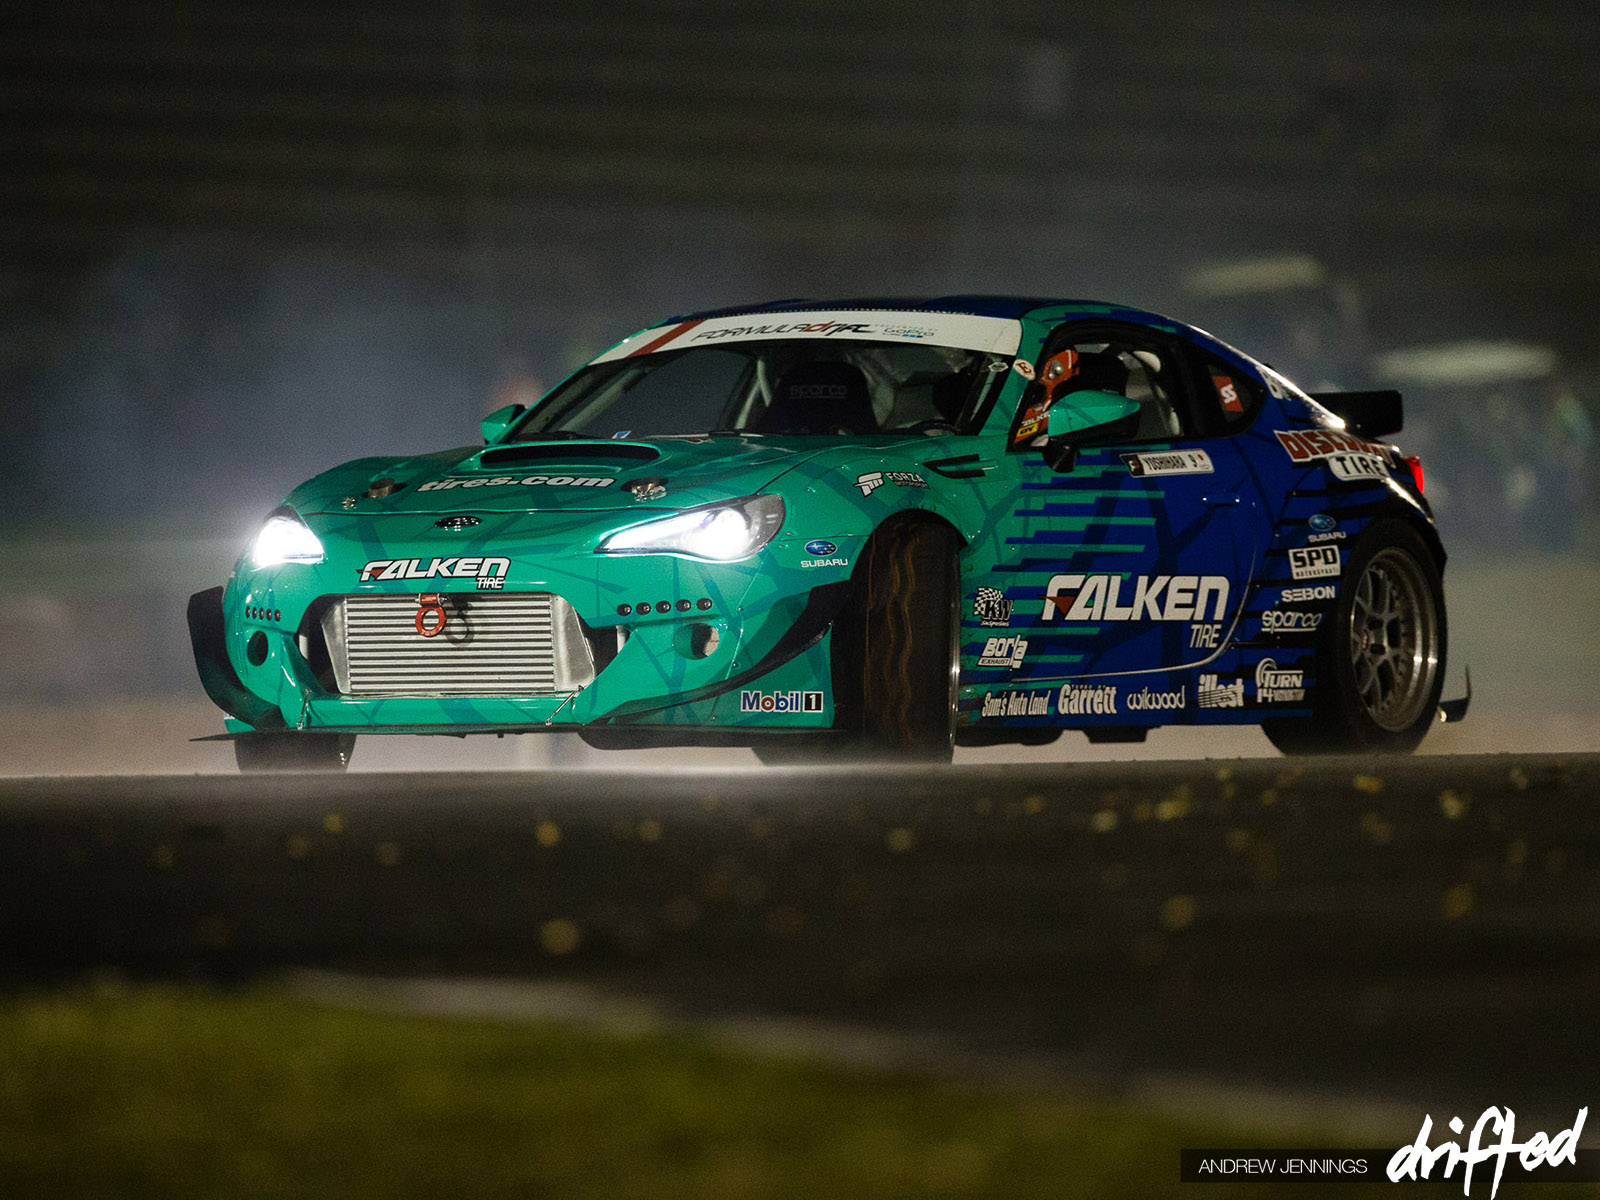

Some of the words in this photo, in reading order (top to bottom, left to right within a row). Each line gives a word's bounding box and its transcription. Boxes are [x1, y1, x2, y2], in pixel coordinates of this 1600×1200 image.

[1336, 455, 1387, 477] TIRE
[417, 475, 615, 492] tires.com
[884, 472, 926, 484] FORZA
[1308, 531, 1347, 543] SUBARU
[800, 558, 849, 569] SUBARU
[1292, 547, 1338, 568] SPD
[358, 556, 512, 582] FALKEN
[476, 577, 505, 589] TIRE
[1281, 585, 1336, 602] SEBON
[1039, 574, 1230, 621] FALKEN
[1261, 610, 1323, 634] sparco
[1189, 624, 1222, 648] TIRE
[1259, 669, 1304, 688] TURN
[741, 690, 801, 712] Mobil
[1007, 691, 1028, 716] Auto
[1028, 690, 1051, 715] Land
[1058, 684, 1117, 714] Garrett
